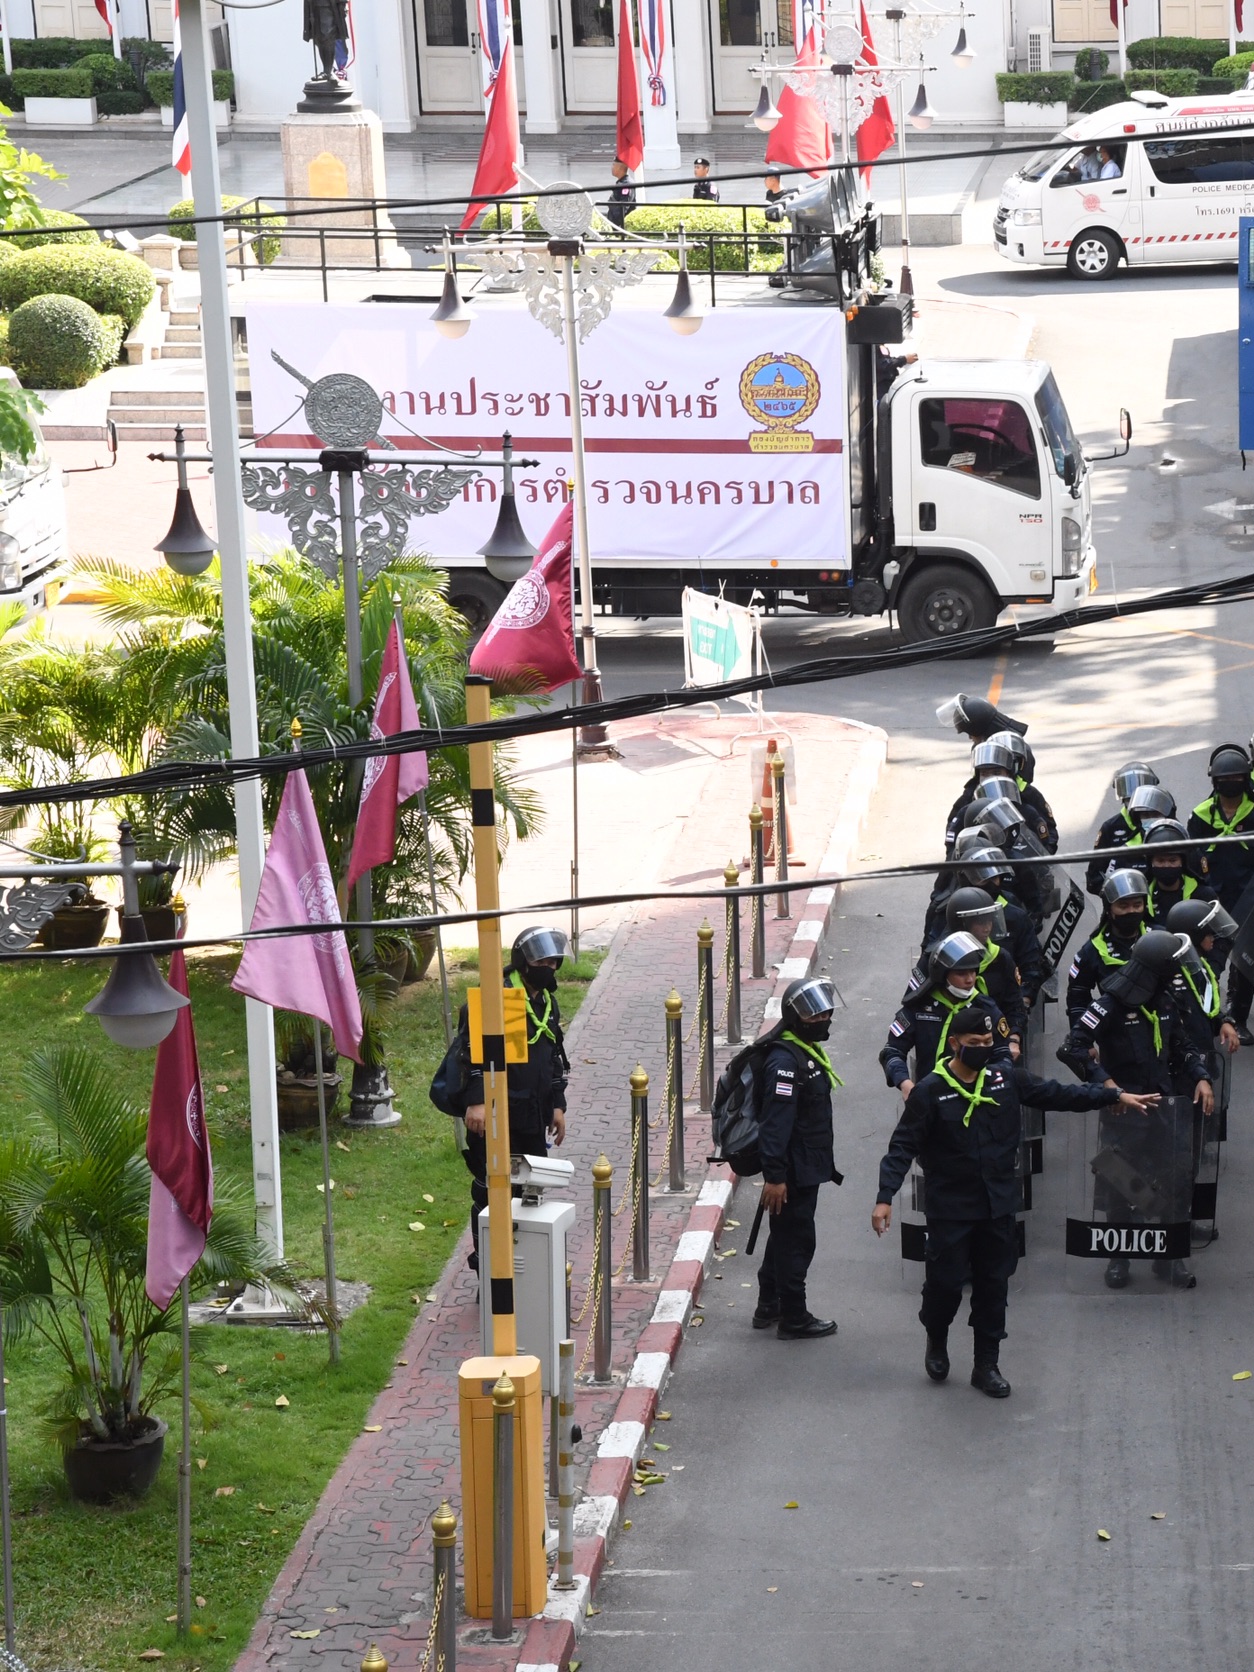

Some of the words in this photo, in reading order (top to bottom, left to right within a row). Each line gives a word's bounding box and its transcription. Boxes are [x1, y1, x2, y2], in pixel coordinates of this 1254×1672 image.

[1192, 185, 1222, 194] POLICE
[1043, 900, 1080, 967] POLICE
[1090, 1001, 1108, 1017] POLICE
[777, 1069, 795, 1079] POLICE
[1089, 1227, 1167, 1253] POLICE
